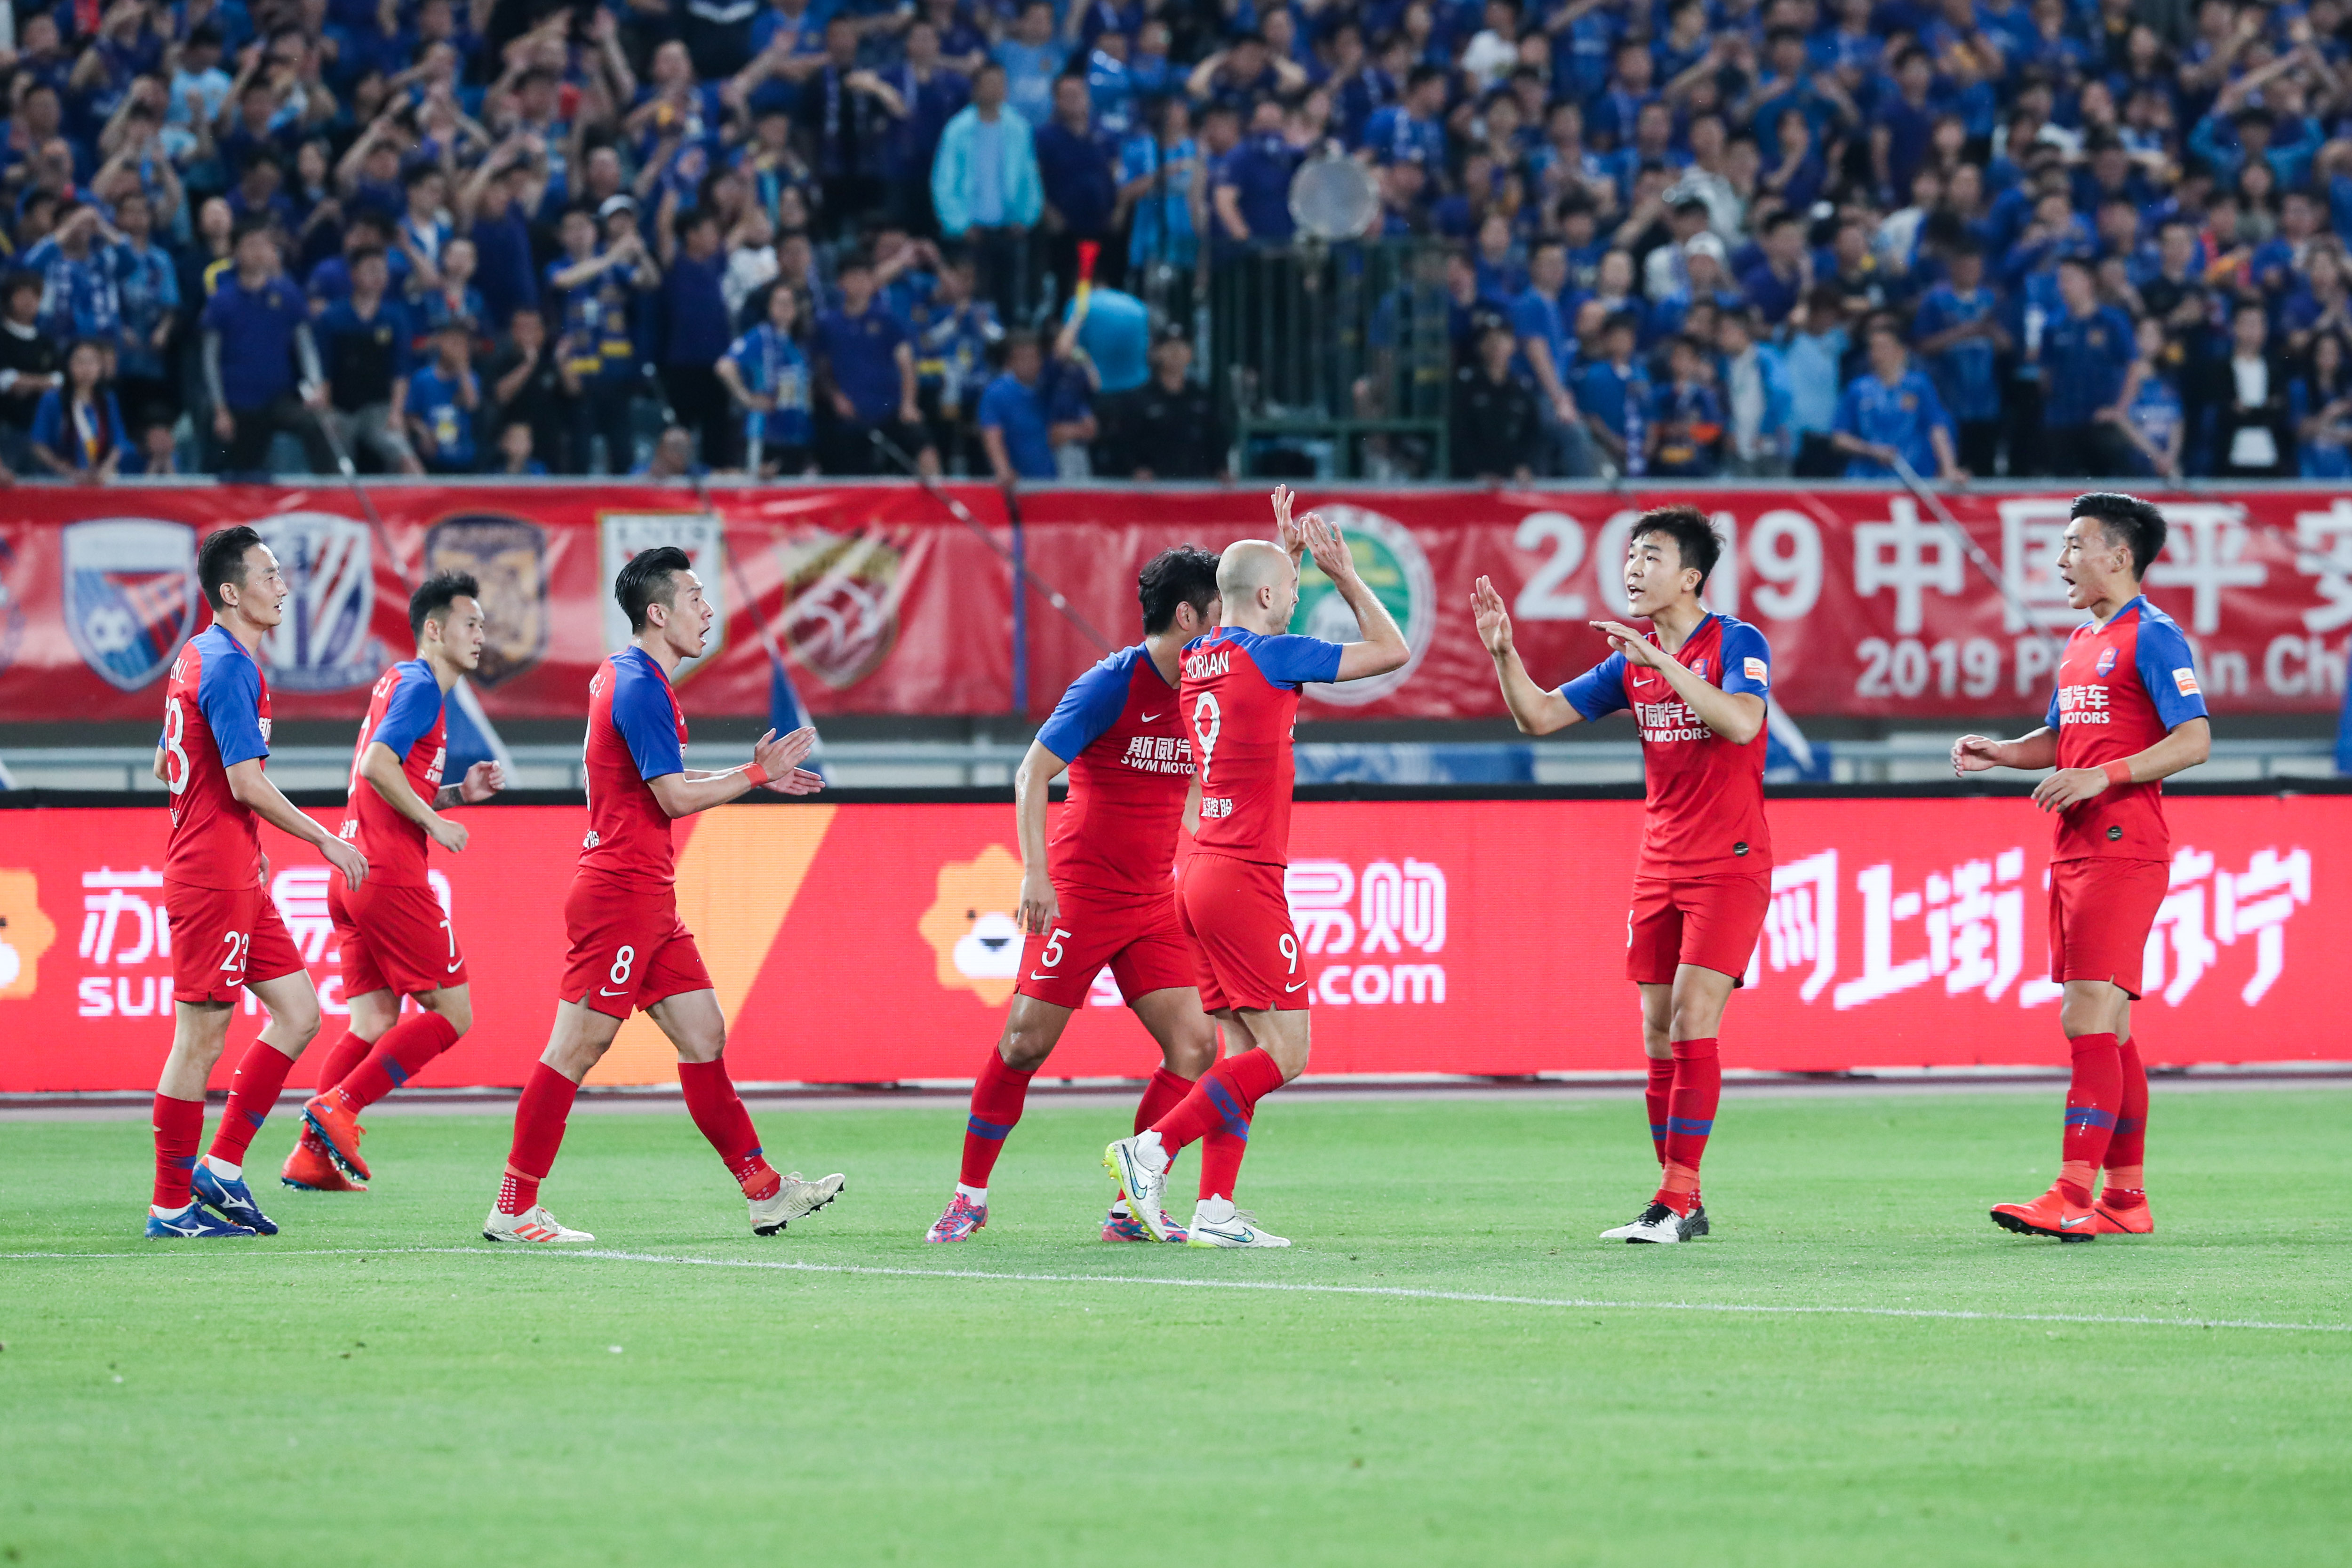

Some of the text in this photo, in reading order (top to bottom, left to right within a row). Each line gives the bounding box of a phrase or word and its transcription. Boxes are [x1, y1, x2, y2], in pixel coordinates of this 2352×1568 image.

[1185, 651, 1229, 678] ADRIAN
[1856, 636, 2000, 698] 2019
[1125, 736, 1195, 762] 斯威汽
[1193, 691, 1220, 783] 9
[1654, 727, 1712, 742] MOTORS
[1120, 756, 1196, 775] SWM MOTO
[439, 918, 455, 958] 7
[1041, 928, 1072, 968] 5
[1741, 846, 2312, 1011] 网上街苏宁
[219, 931, 249, 972] 23
[609, 945, 635, 985] 8
[1278, 933, 1298, 975] 9
